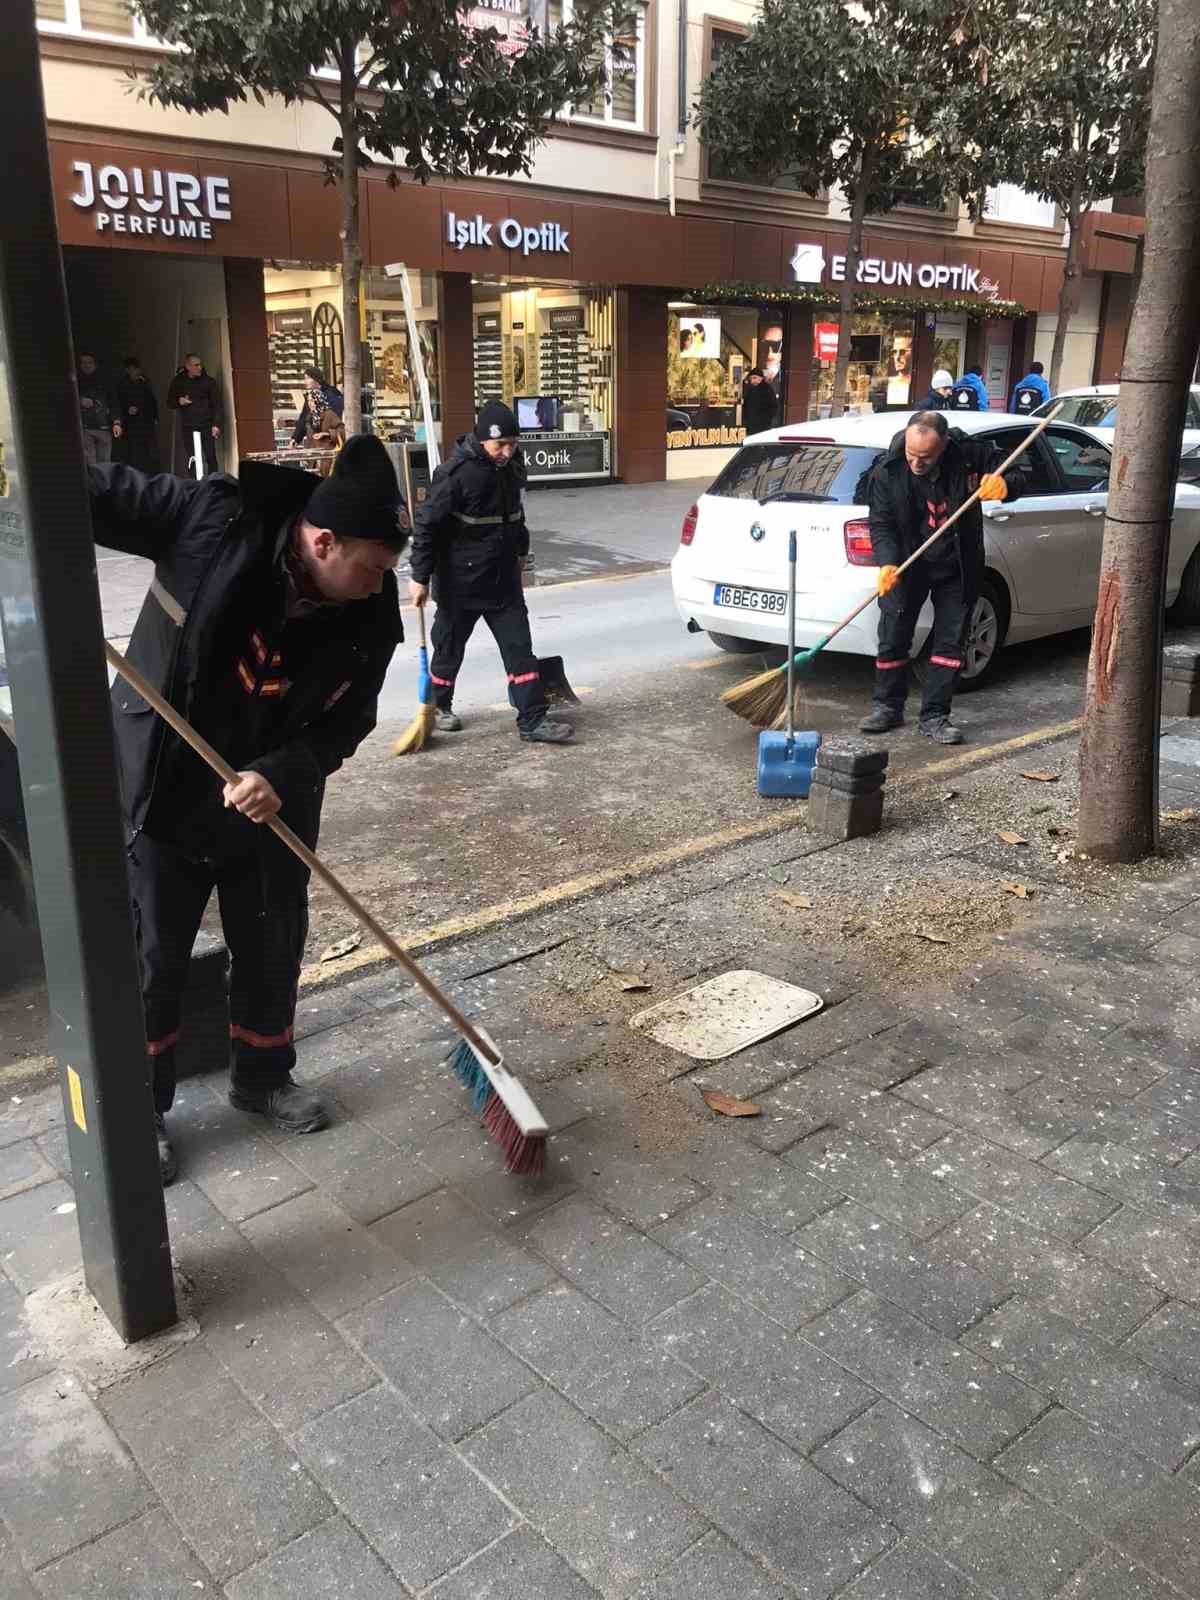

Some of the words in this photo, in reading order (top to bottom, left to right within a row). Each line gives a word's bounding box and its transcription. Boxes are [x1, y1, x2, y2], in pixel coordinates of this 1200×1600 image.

[71, 160, 232, 221] JOURE
[96, 212, 213, 239] PERFUME
[448, 211, 494, 250] Işık
[500, 218, 570, 256] Optik
[916, 264, 981, 293] OPTİK
[535, 449, 571, 469] Optik
[733, 590, 759, 608] BEG
[760, 594, 785, 612] 989
